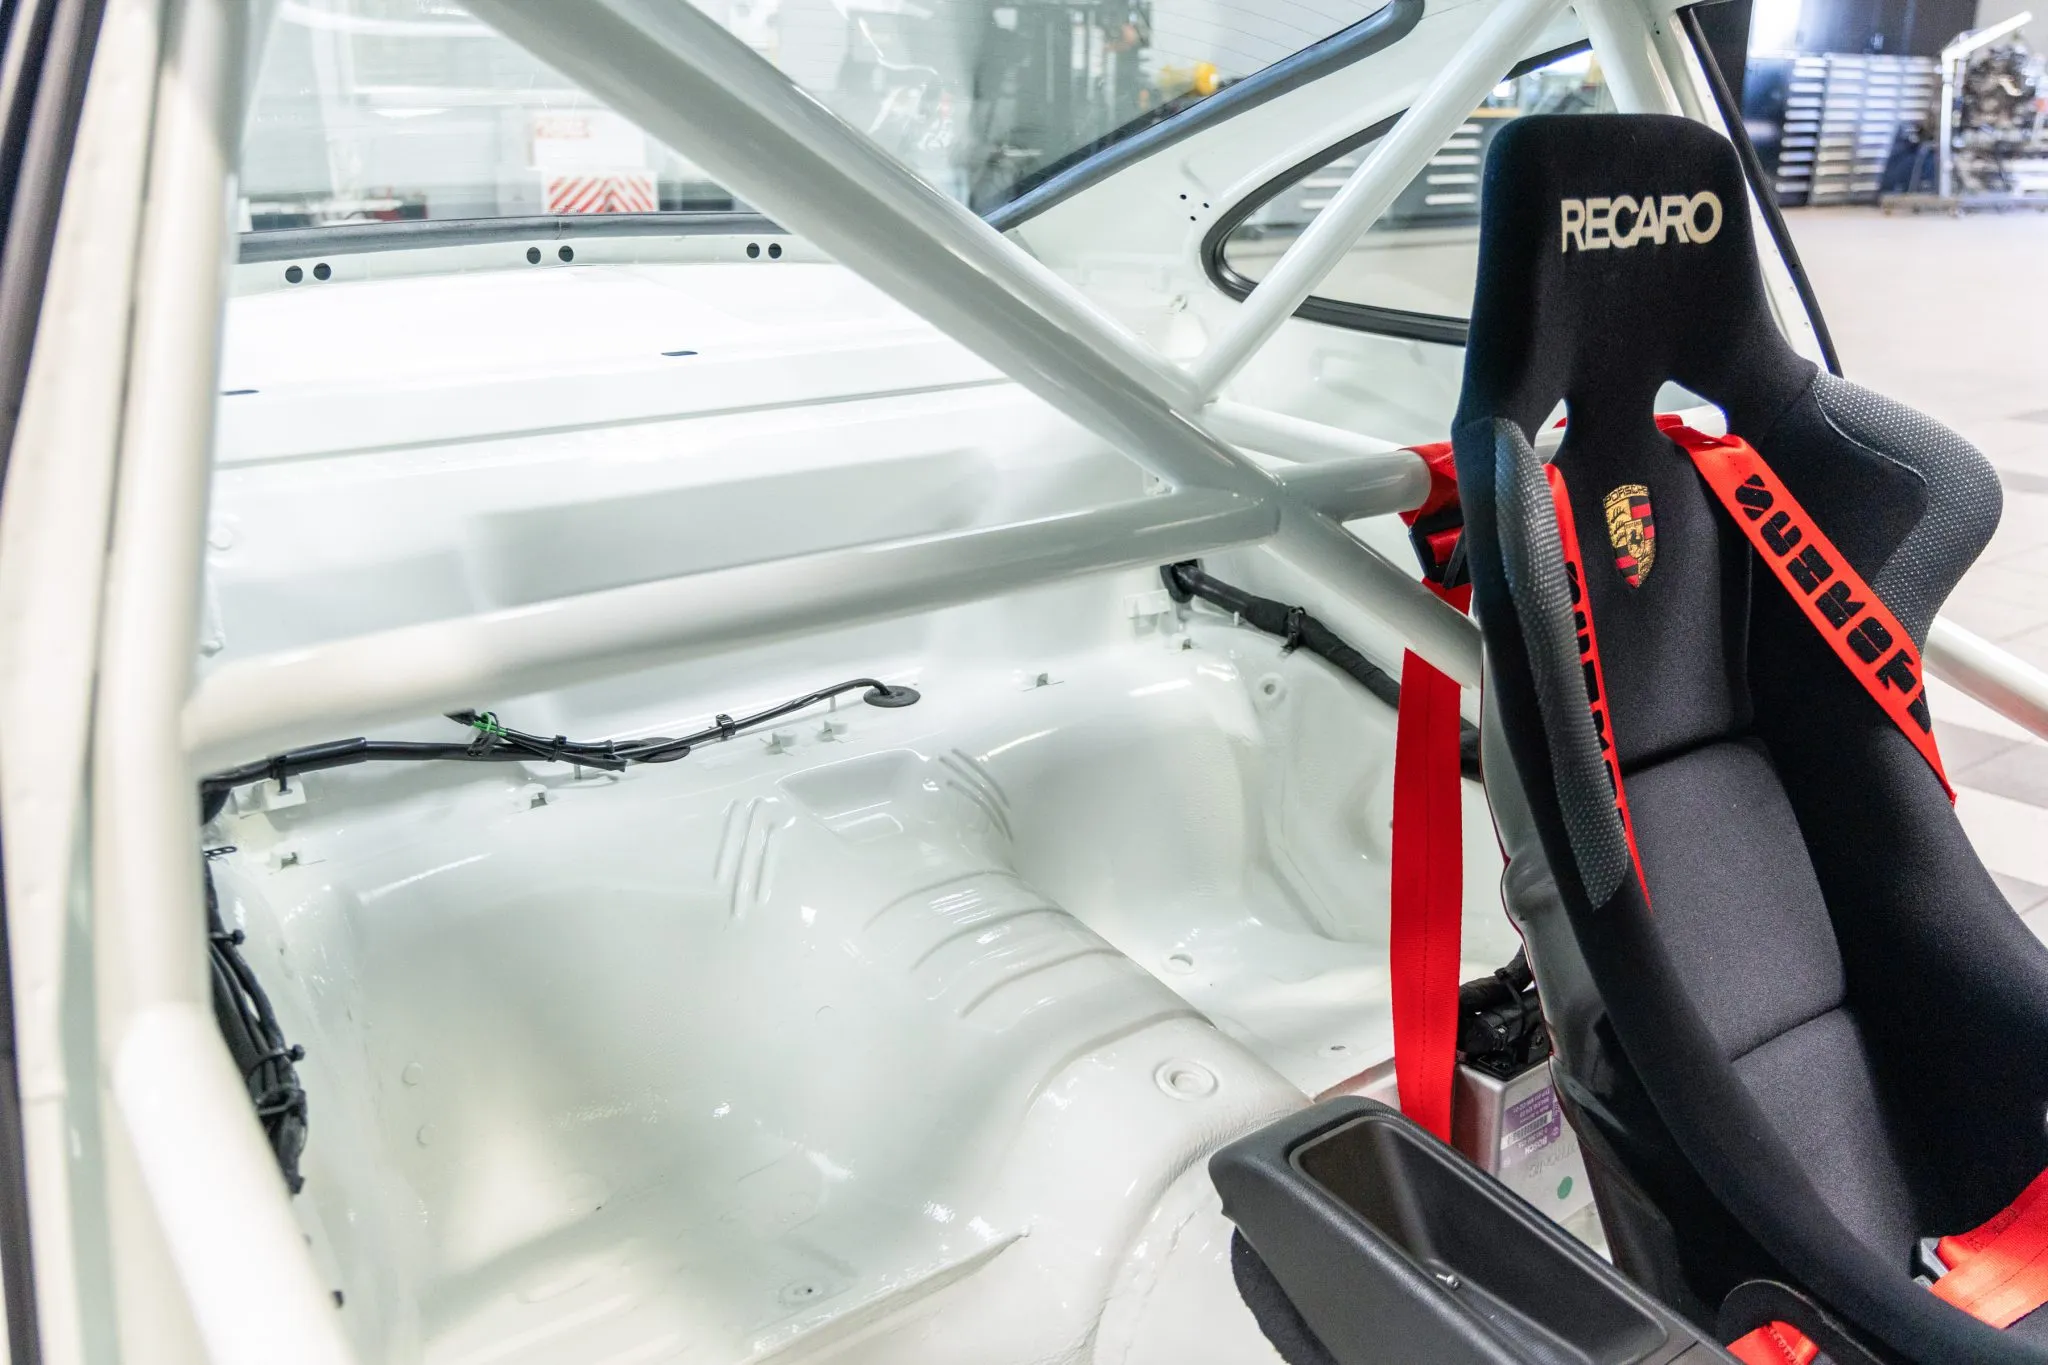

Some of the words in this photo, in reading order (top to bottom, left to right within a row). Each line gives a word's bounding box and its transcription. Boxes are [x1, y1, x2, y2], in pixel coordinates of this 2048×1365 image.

[1561, 191, 1723, 253] RECARO
[1603, 485, 1649, 506] PORSCHE
[1524, 1136, 1548, 1155] BOSCH
